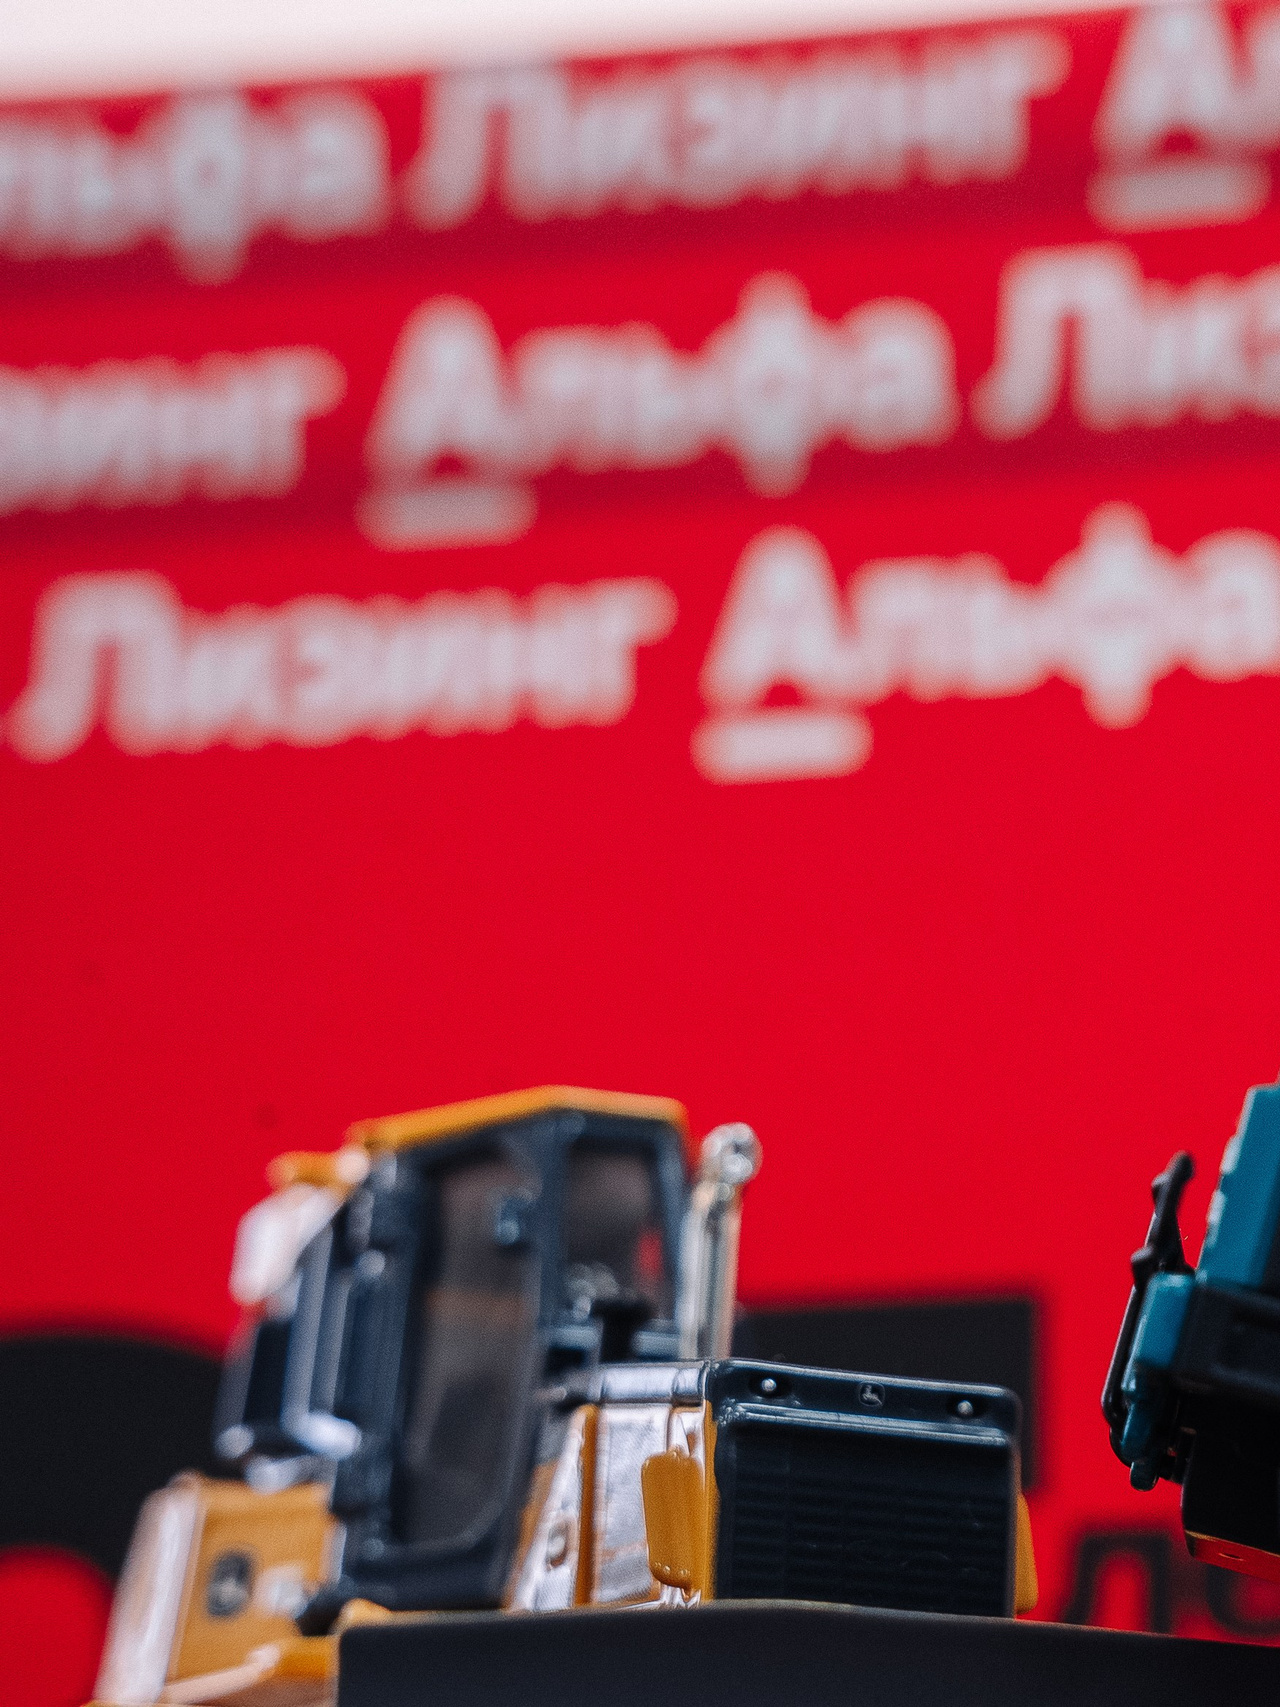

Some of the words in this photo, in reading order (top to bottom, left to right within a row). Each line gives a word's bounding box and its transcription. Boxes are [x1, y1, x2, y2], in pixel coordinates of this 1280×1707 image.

[408, 24, 1070, 224] Лизинг
[370, 274, 956, 494] Альфа
[13, 573, 675, 758] Лизинг
